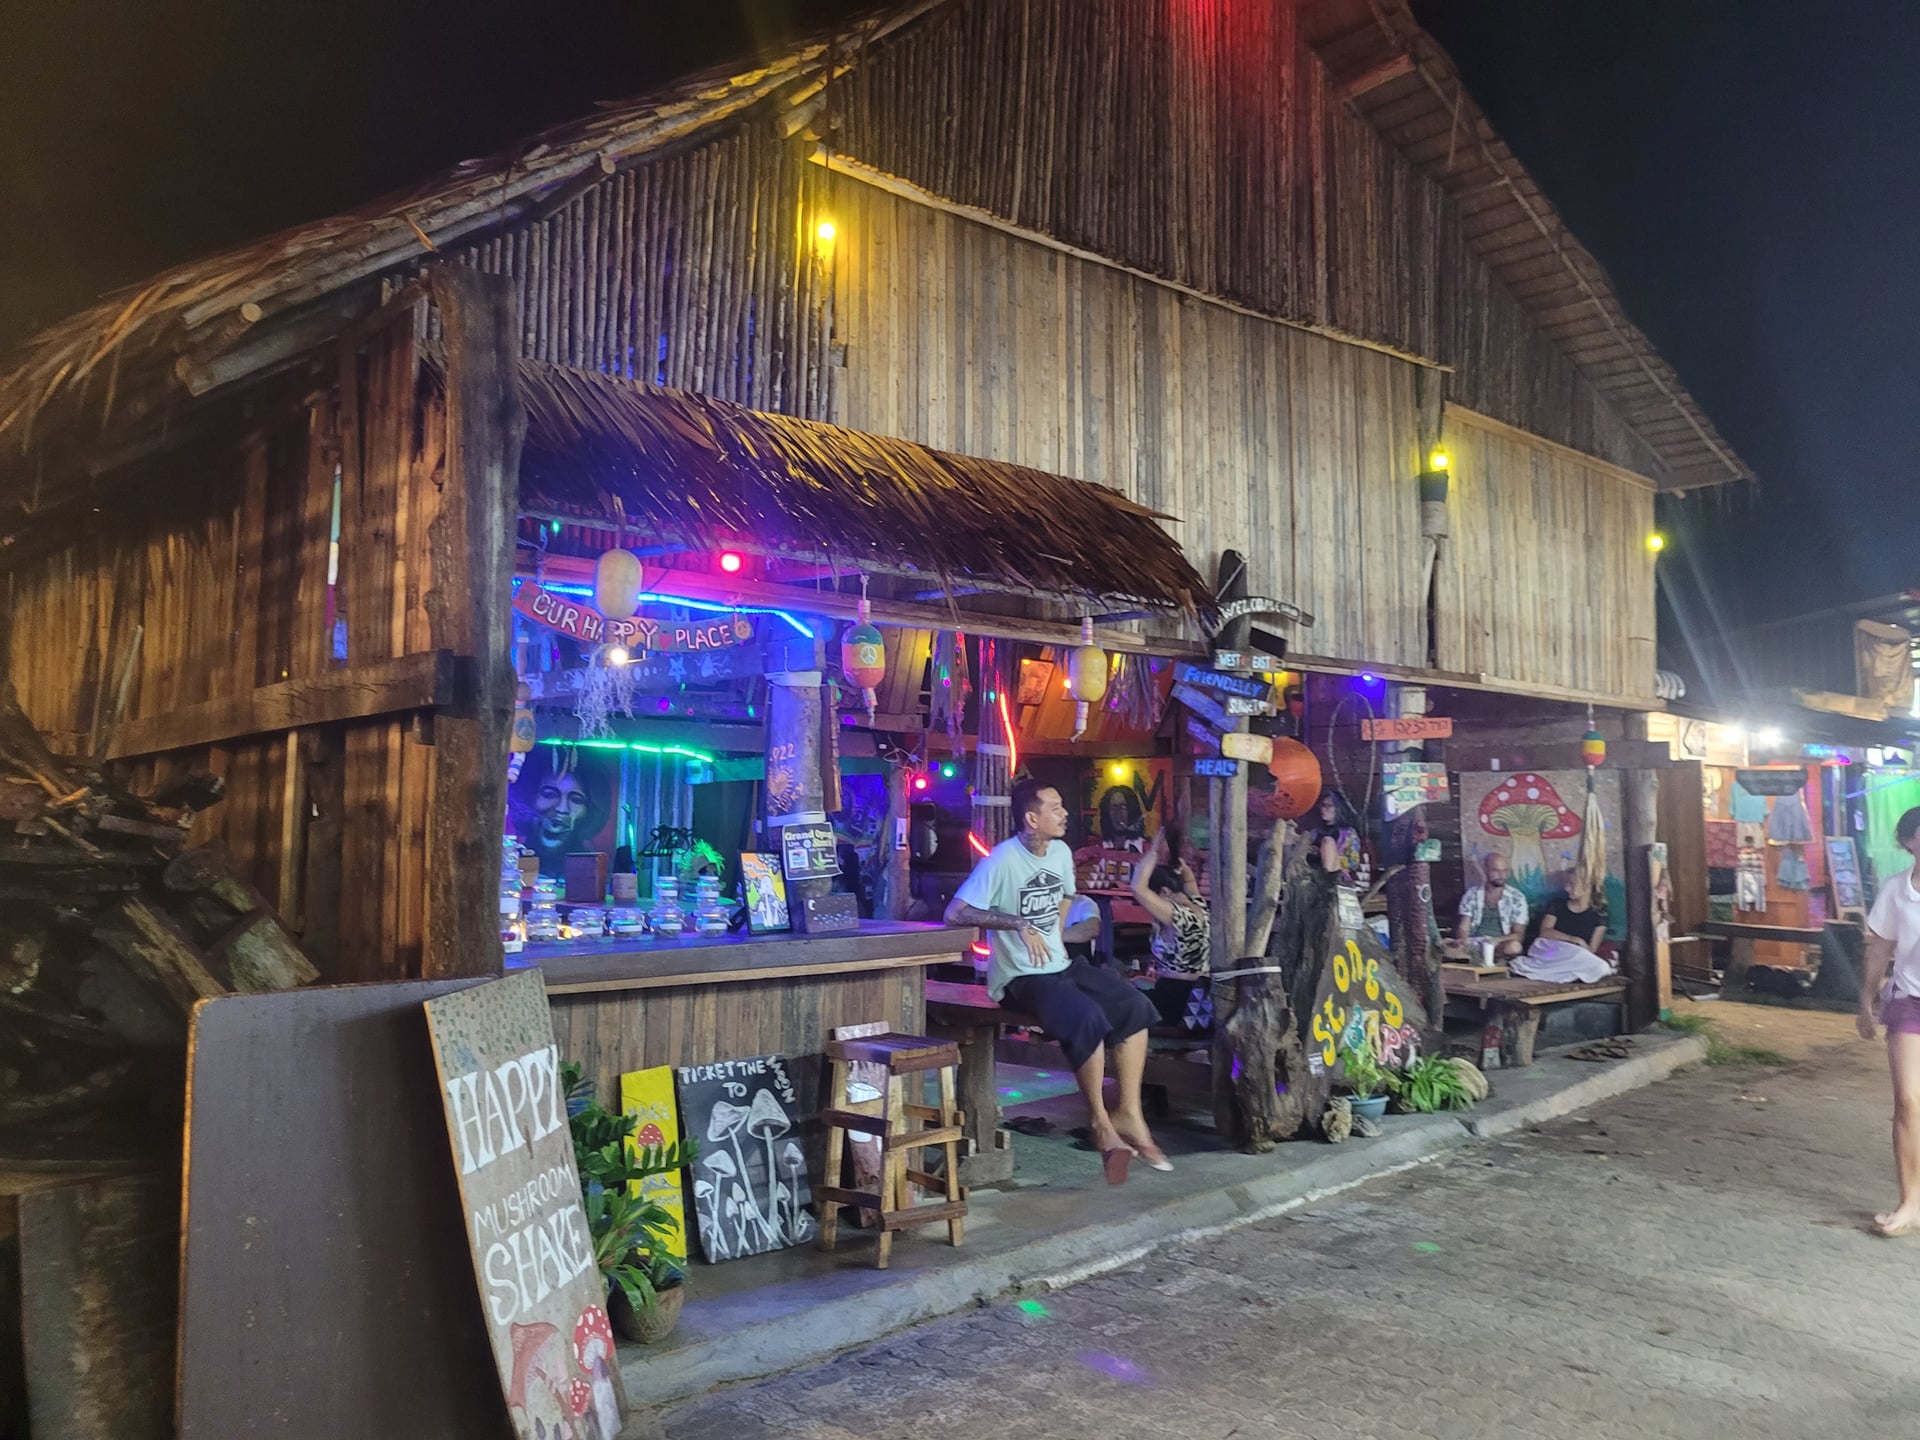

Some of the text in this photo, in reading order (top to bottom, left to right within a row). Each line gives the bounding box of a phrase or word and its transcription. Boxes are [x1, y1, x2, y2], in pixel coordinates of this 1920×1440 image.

[533, 593, 577, 633] OUR
[675, 624, 733, 649] PLACE
[679, 1061, 735, 1084] TICKET
[722, 1082, 747, 1098] TO
[447, 1045, 562, 1174] HAPPY
[475, 1163, 575, 1246] MUSHROOM
[484, 1202, 593, 1326] SHAKE
